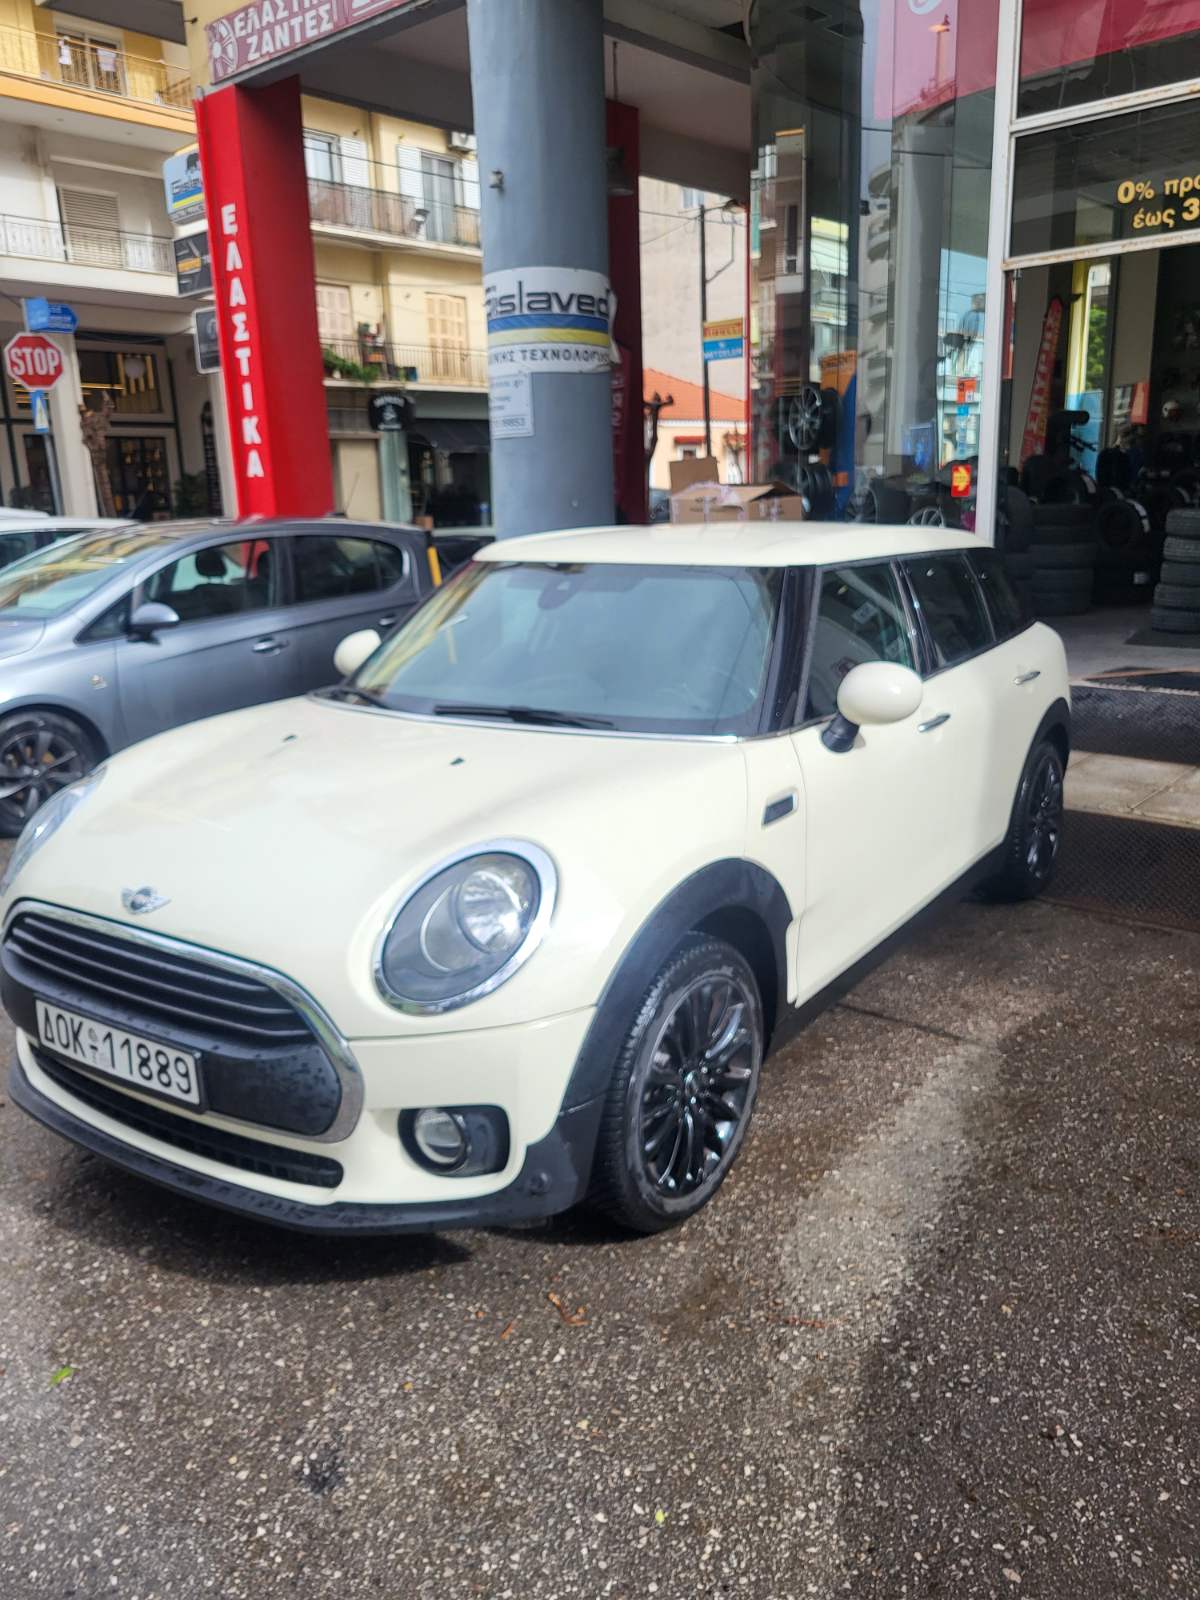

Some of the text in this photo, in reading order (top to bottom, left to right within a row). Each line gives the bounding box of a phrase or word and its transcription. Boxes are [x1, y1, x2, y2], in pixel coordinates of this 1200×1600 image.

[233, 0, 323, 38] ΕΛΑΣΤ
[246, 4, 334, 61] ΖΑΝΤΕΣ
[1117, 180, 1154, 204] 0%
[1132, 208, 1175, 229] έως
[221, 203, 265, 478] ΕΛΑΣΤΙΚΑ
[10, 347, 60, 376] STOP
[44, 1007, 191, 1095] ΔΟΚ-11889
